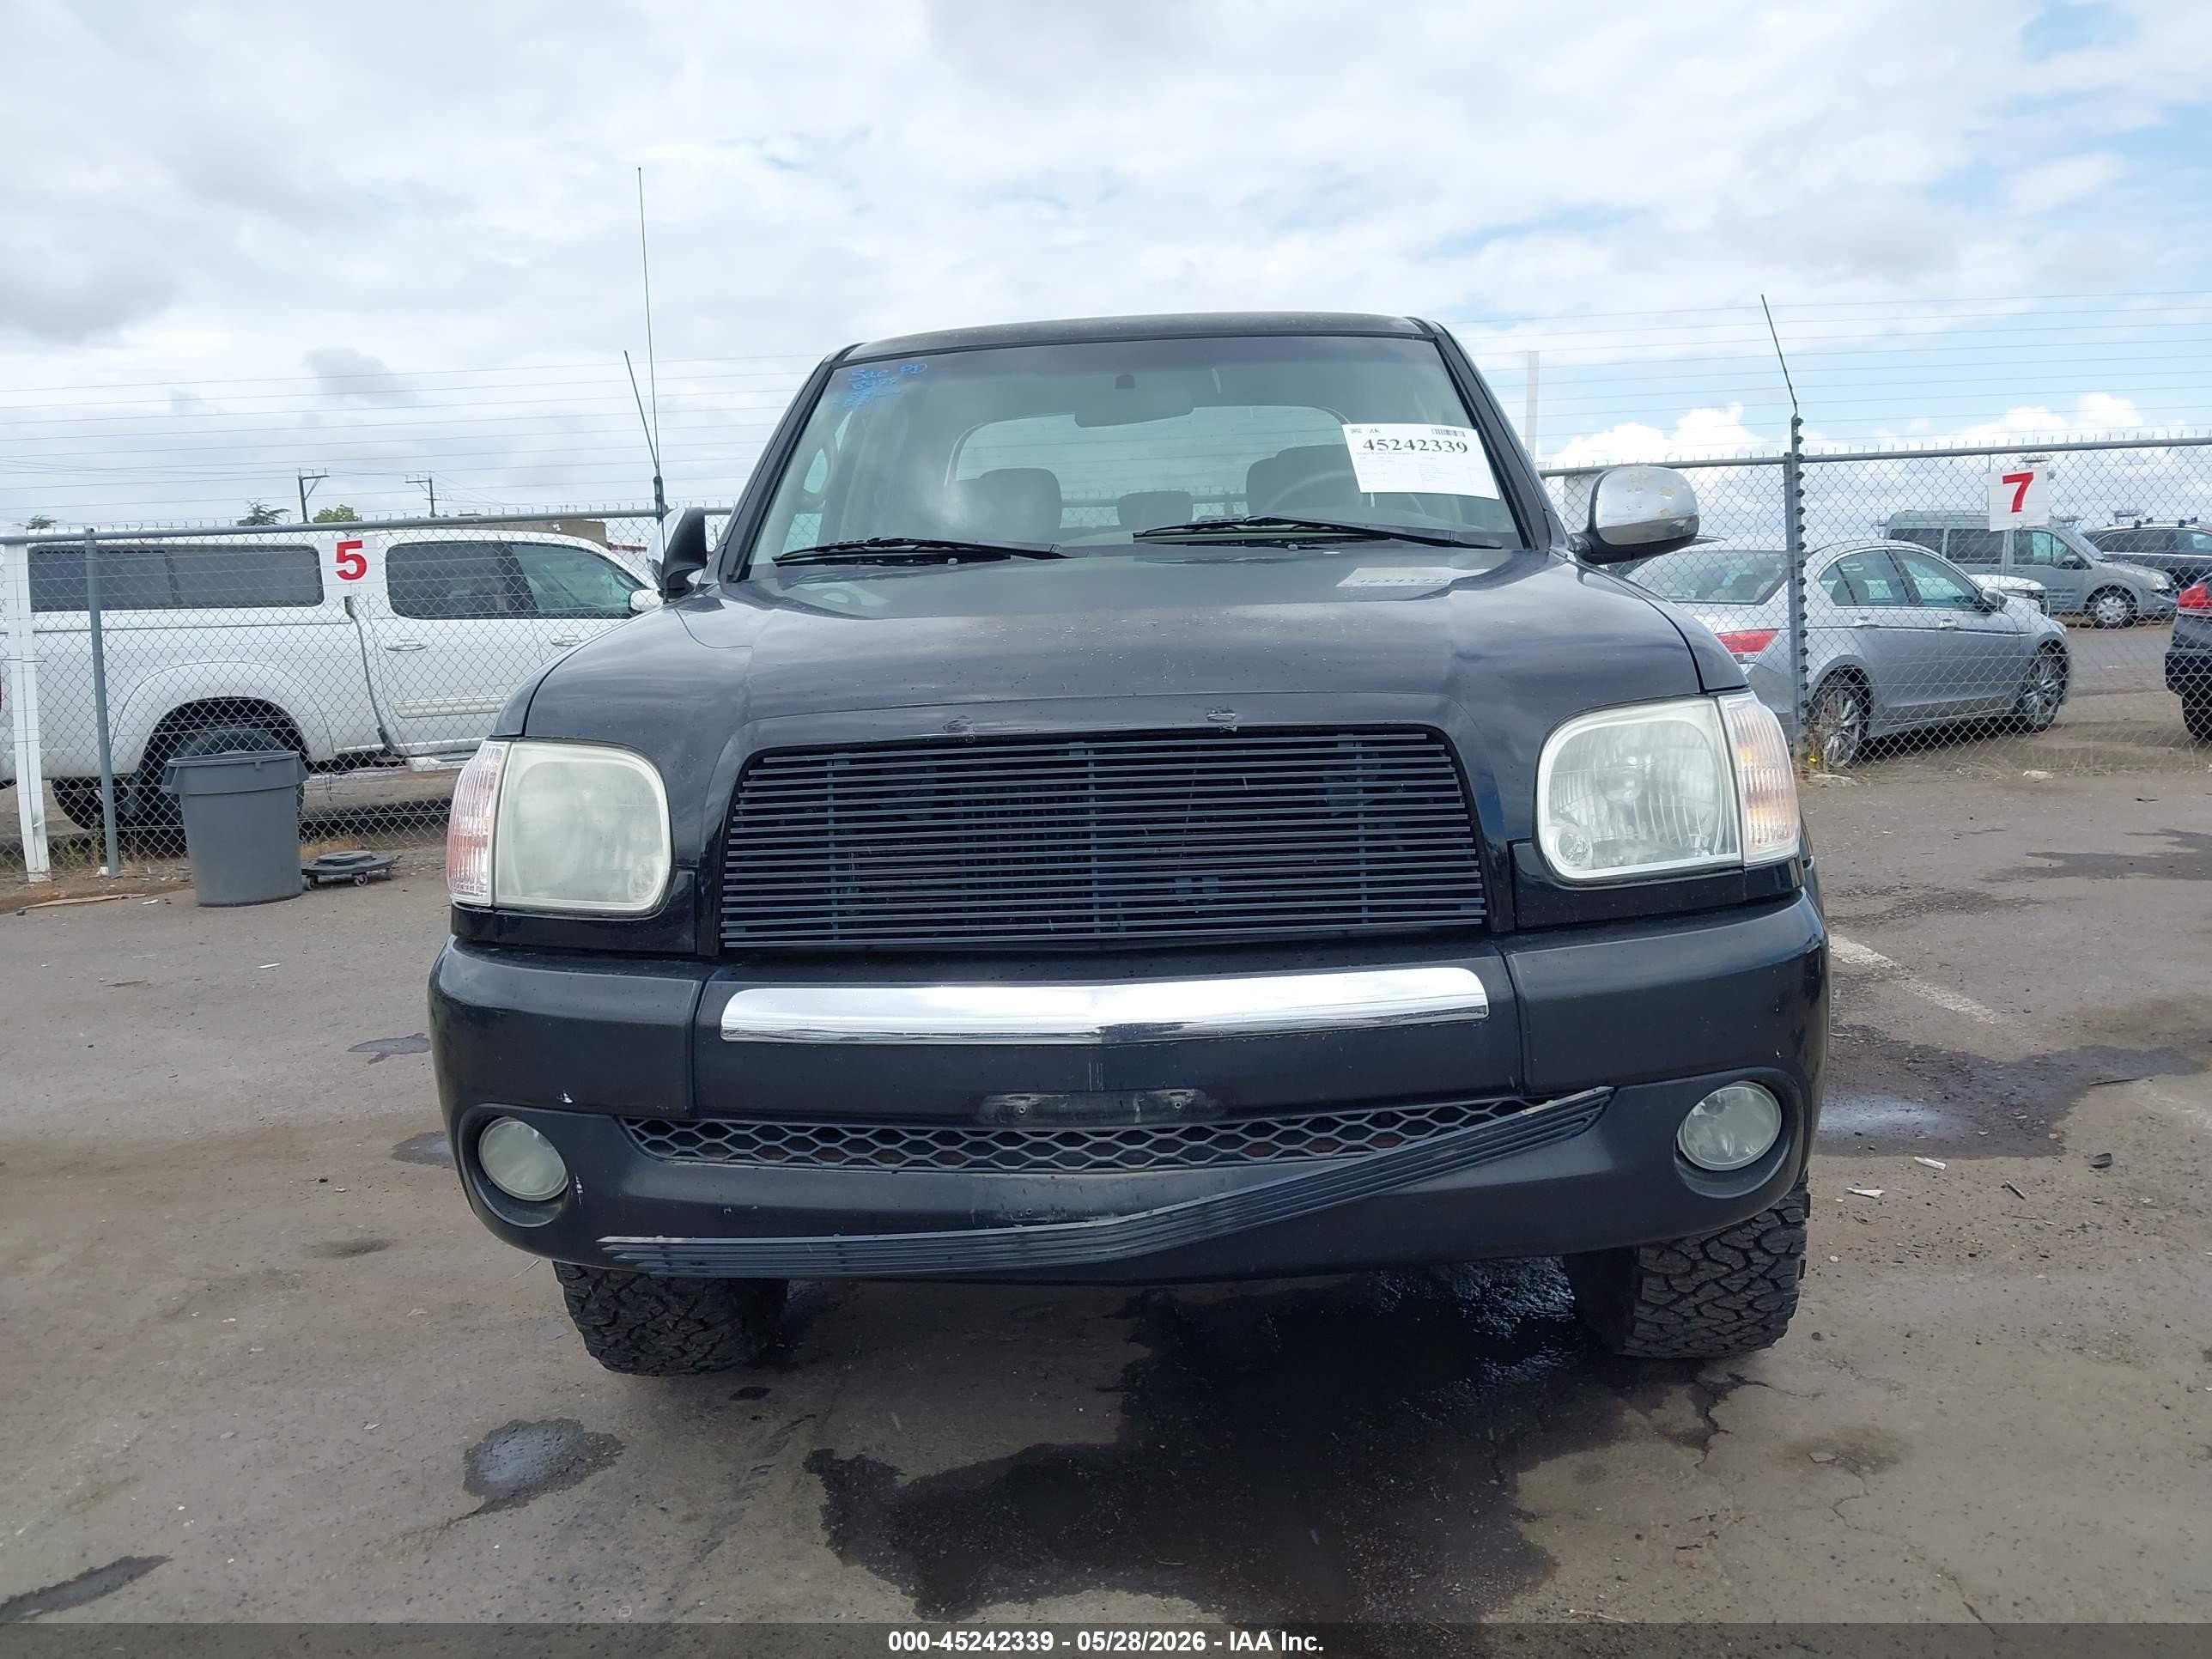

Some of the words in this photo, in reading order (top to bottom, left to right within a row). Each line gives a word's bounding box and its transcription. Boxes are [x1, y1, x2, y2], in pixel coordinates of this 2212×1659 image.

[1363, 439, 1468, 453] 45242339
[2002, 471, 2034, 514] 7
[335, 539, 368, 580] 5
